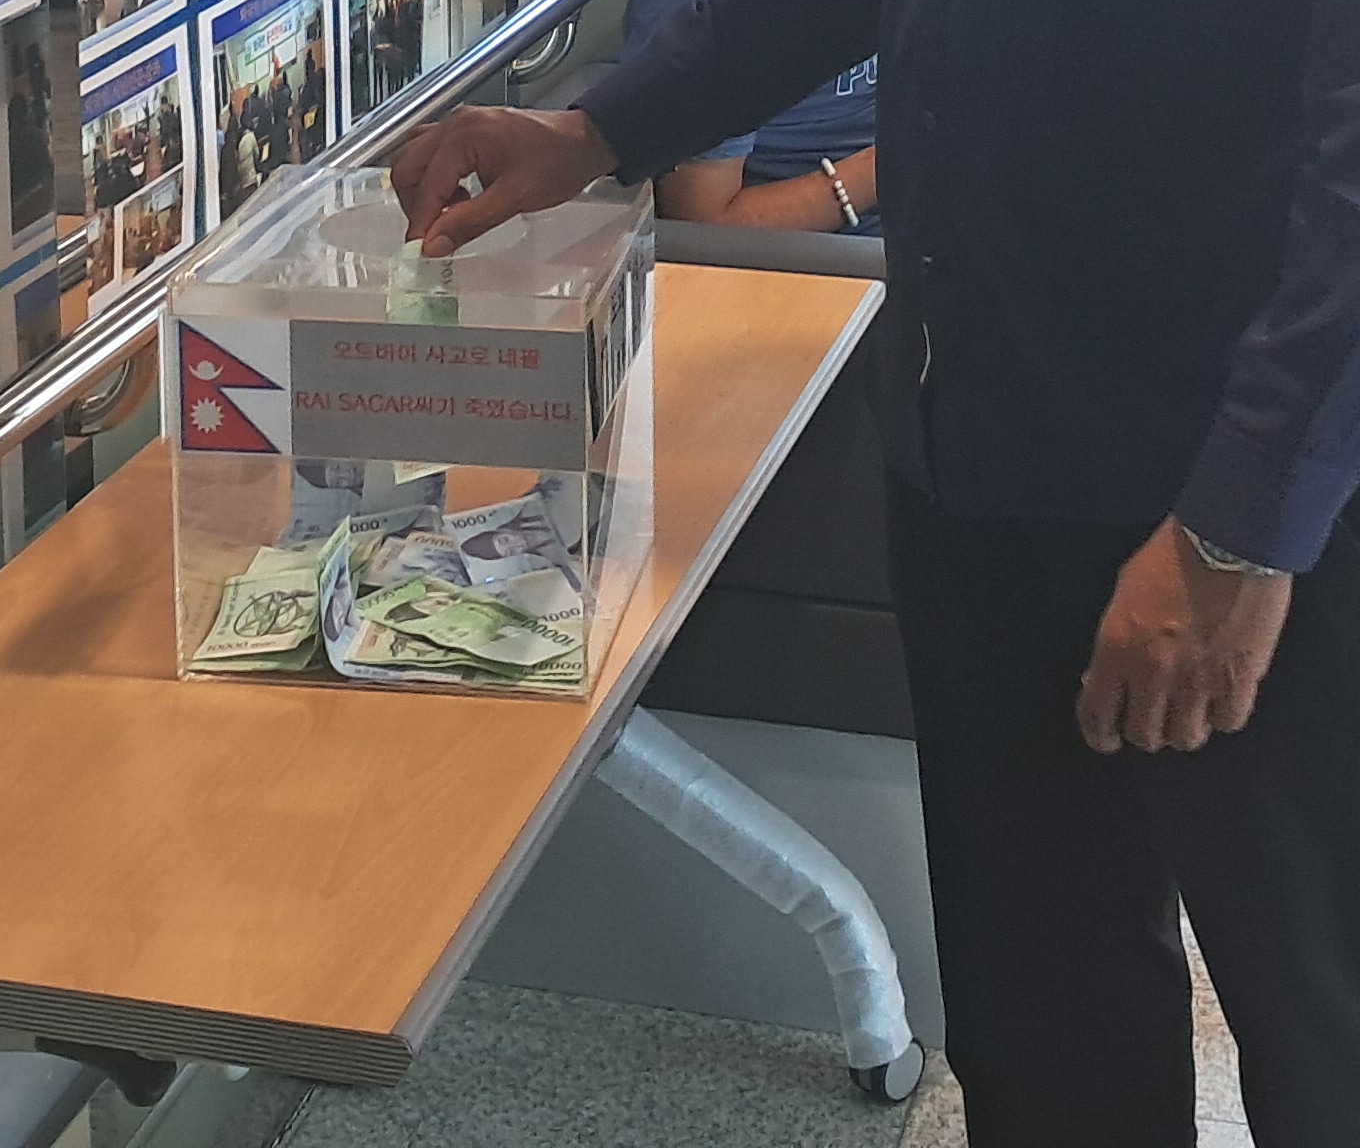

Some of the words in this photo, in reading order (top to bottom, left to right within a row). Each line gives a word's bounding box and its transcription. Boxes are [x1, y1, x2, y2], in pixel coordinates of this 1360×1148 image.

[425, 345, 489, 366] 사고로
[295, 390, 332, 411] RAI
[451, 514, 487, 530] 1000
